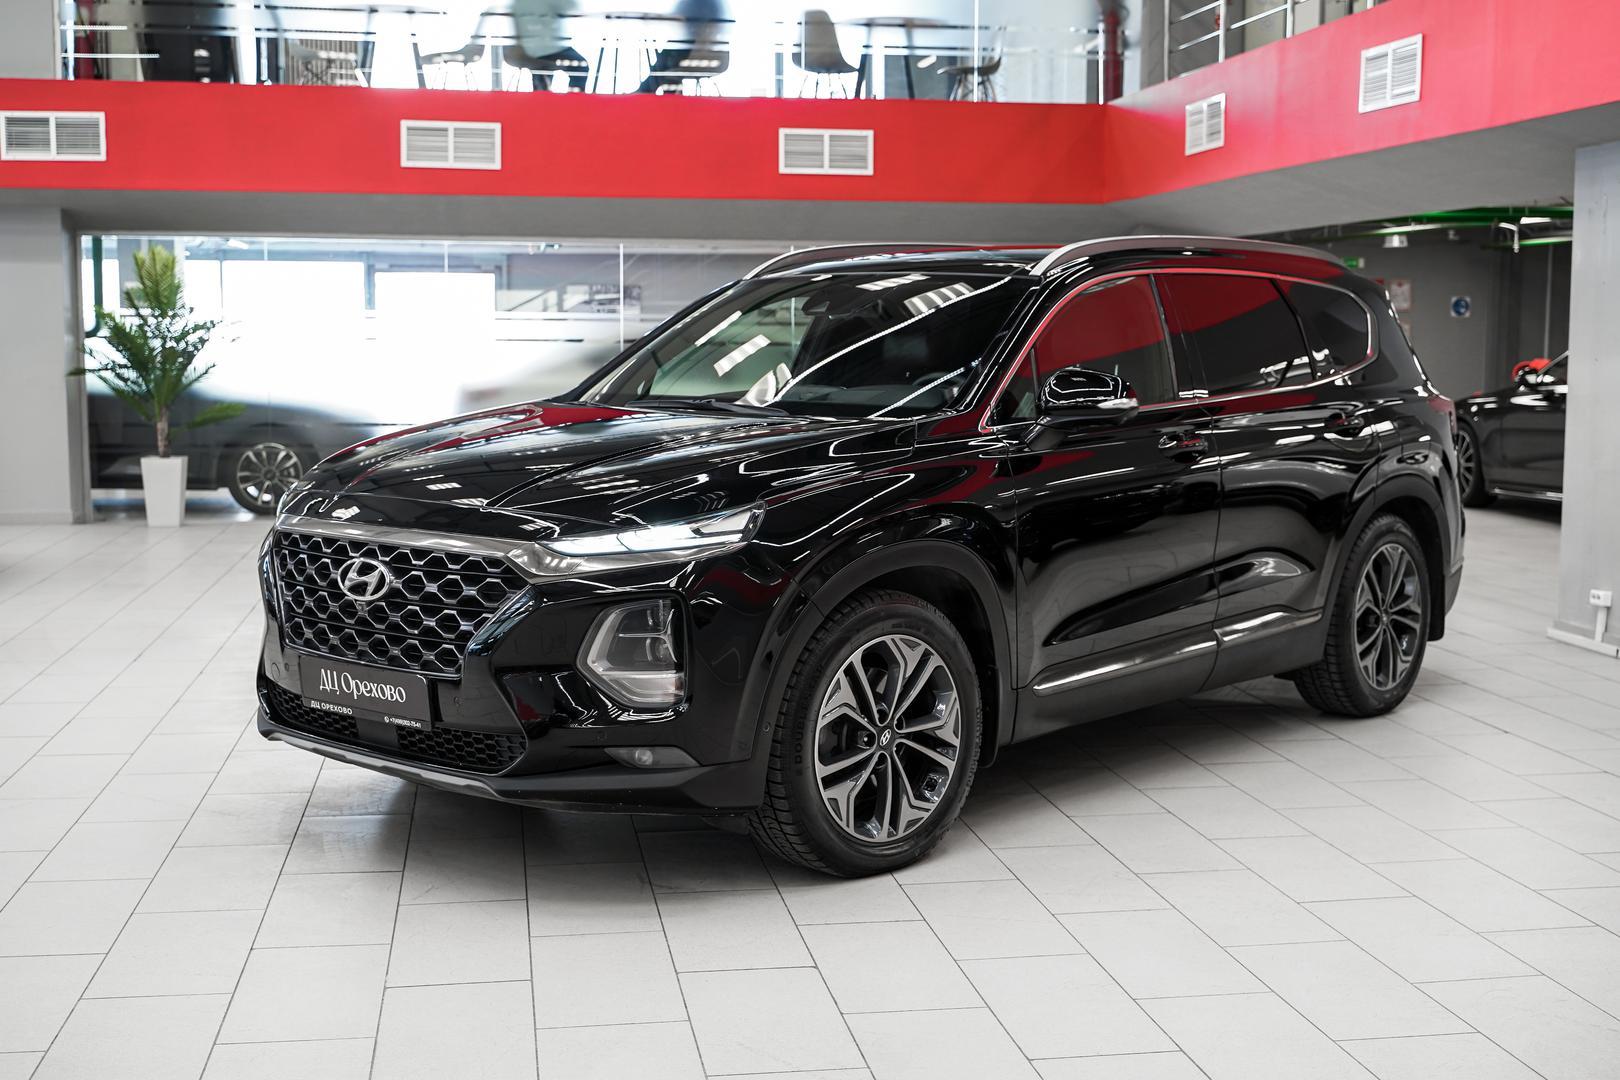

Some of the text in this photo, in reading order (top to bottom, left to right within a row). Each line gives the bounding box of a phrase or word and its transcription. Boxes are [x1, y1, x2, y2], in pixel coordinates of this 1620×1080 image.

[320, 668, 406, 703] ДЦ Орехово
[310, 700, 353, 715] ДЦ ОРЕХОВО
